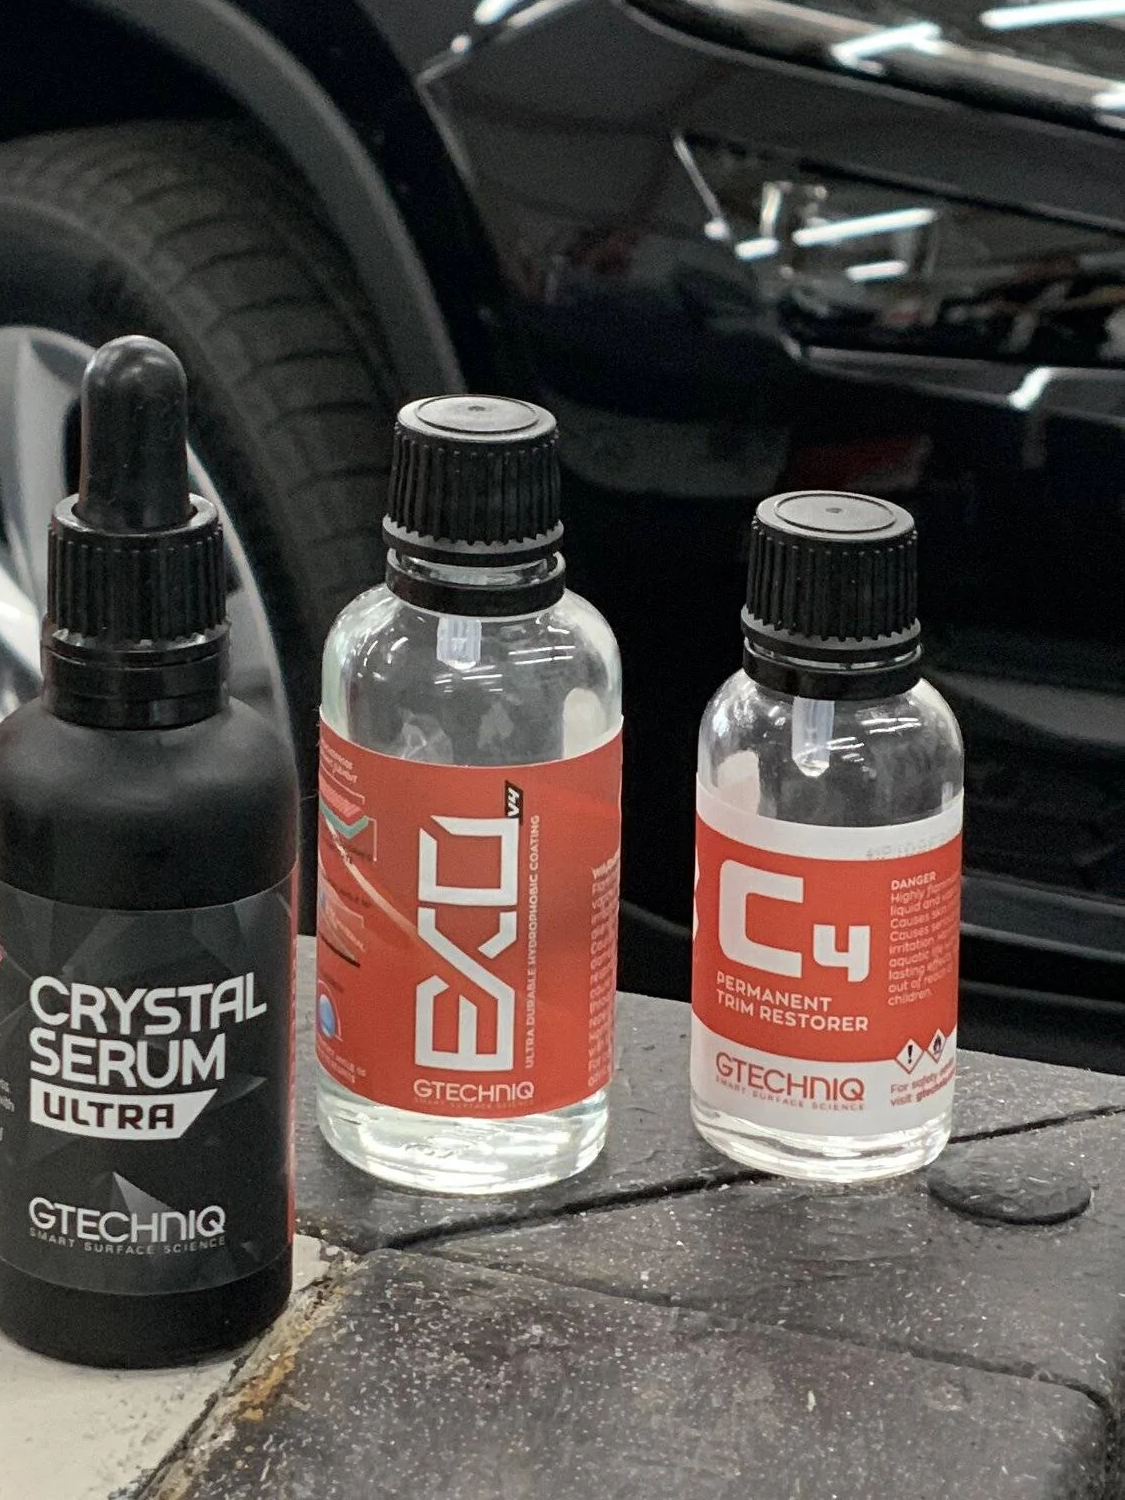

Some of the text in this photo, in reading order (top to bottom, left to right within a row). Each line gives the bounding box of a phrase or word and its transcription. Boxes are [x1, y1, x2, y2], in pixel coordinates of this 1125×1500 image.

[891, 871, 936, 890] DANGER
[891, 888, 925, 904] Highly
[890, 900, 921, 916] liquid
[890, 913, 930, 929] Causes
[414, 815, 520, 1072] EXO
[525, 815, 540, 1069] ULTRA DURABLE HYDROPHOBIC COATING
[890, 925, 929, 941] Causes
[888, 981, 908, 993] out
[910, 975, 922, 990] of
[889, 965, 925, 981] lasting
[29, 972, 267, 1036] CRYSTAL
[716, 970, 832, 1012] PERMANENT
[716, 989, 868, 1032] TRIM RESTORER
[29, 1027, 226, 1089] SERUM
[413, 1079, 534, 1103] GTECHNIQ
[715, 1051, 864, 1102] GTECHNIQ
[890, 1083, 908, 1094] For
[716, 1075, 864, 1111] SMART SURFACE SCIENCE
[44, 1090, 175, 1130] ULTRA
[29, 1197, 225, 1244] GTECHNIQ
[29, 1227, 225, 1255] SMART SURFACE SCIENCE
